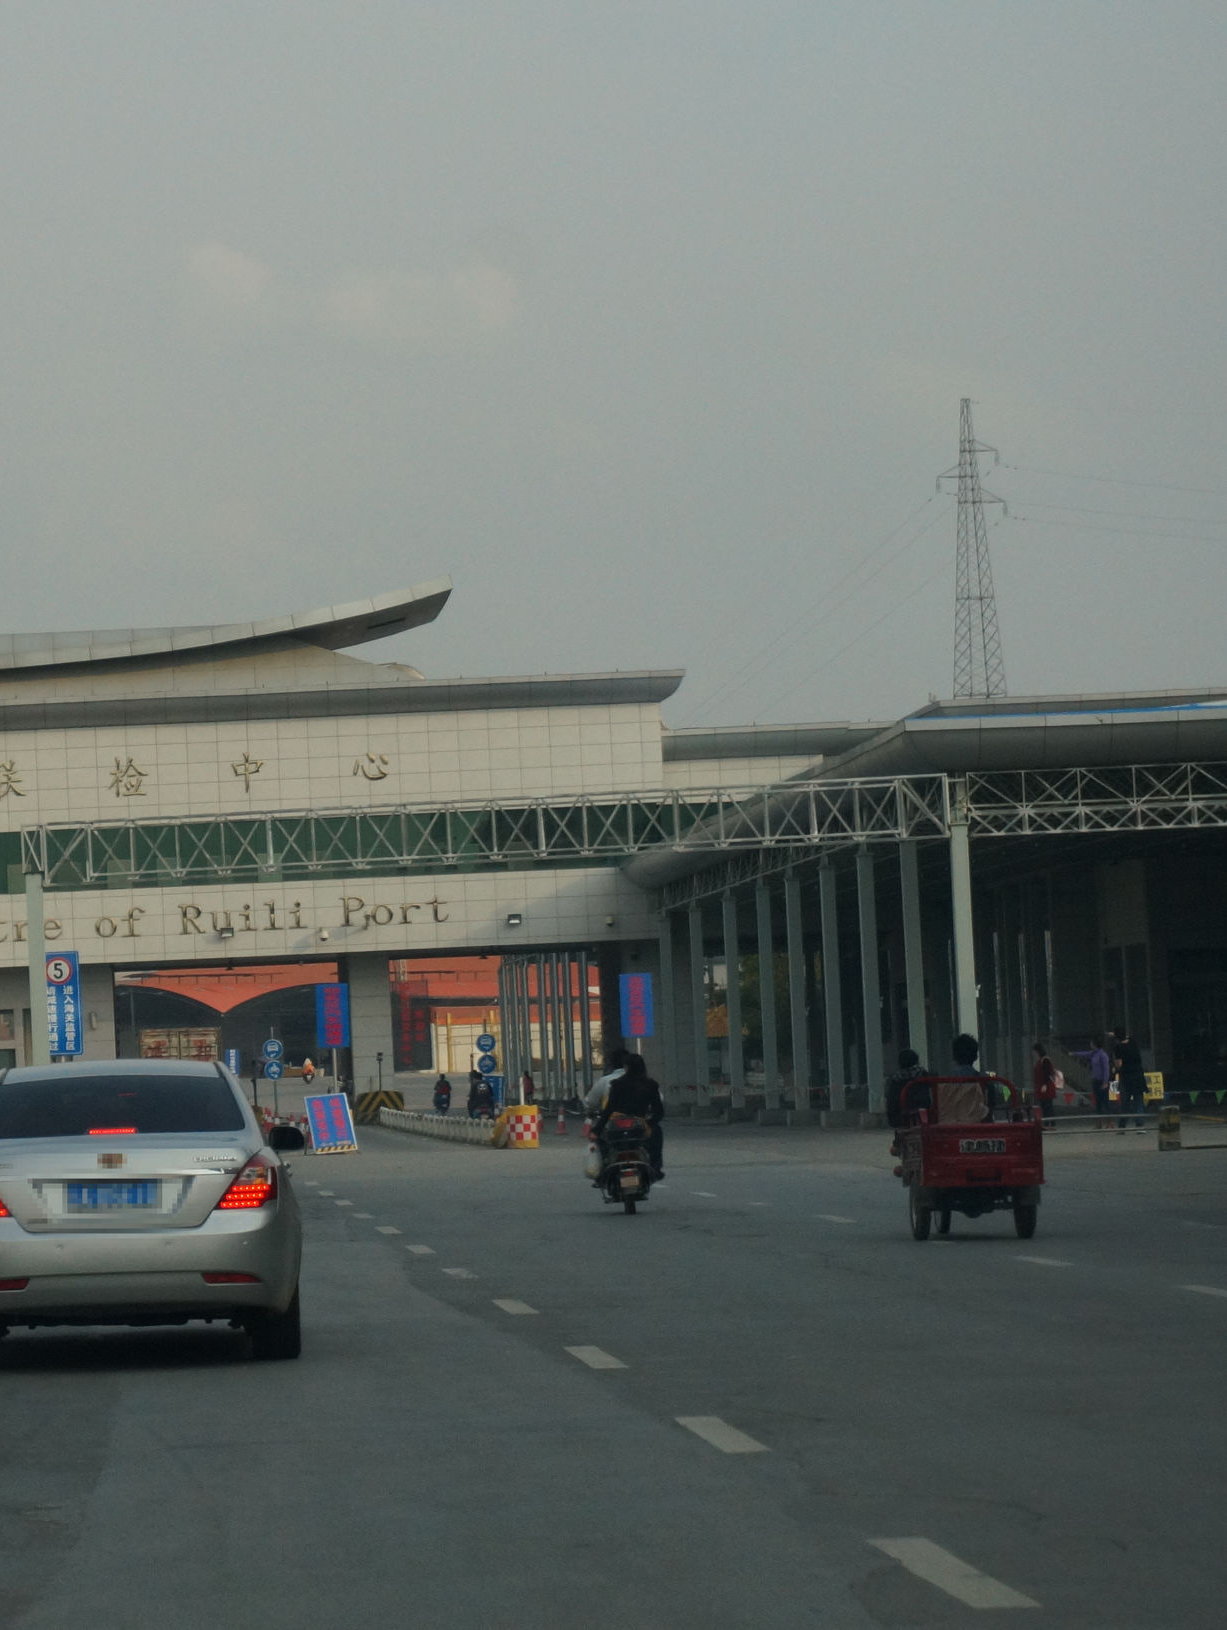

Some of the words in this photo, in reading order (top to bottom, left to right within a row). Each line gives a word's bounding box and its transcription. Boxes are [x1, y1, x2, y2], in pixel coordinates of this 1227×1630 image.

[94, 907, 146, 940] of
[177, 899, 309, 936] Ruili
[339, 894, 451, 929] Port
[53, 962, 64, 980] 5
